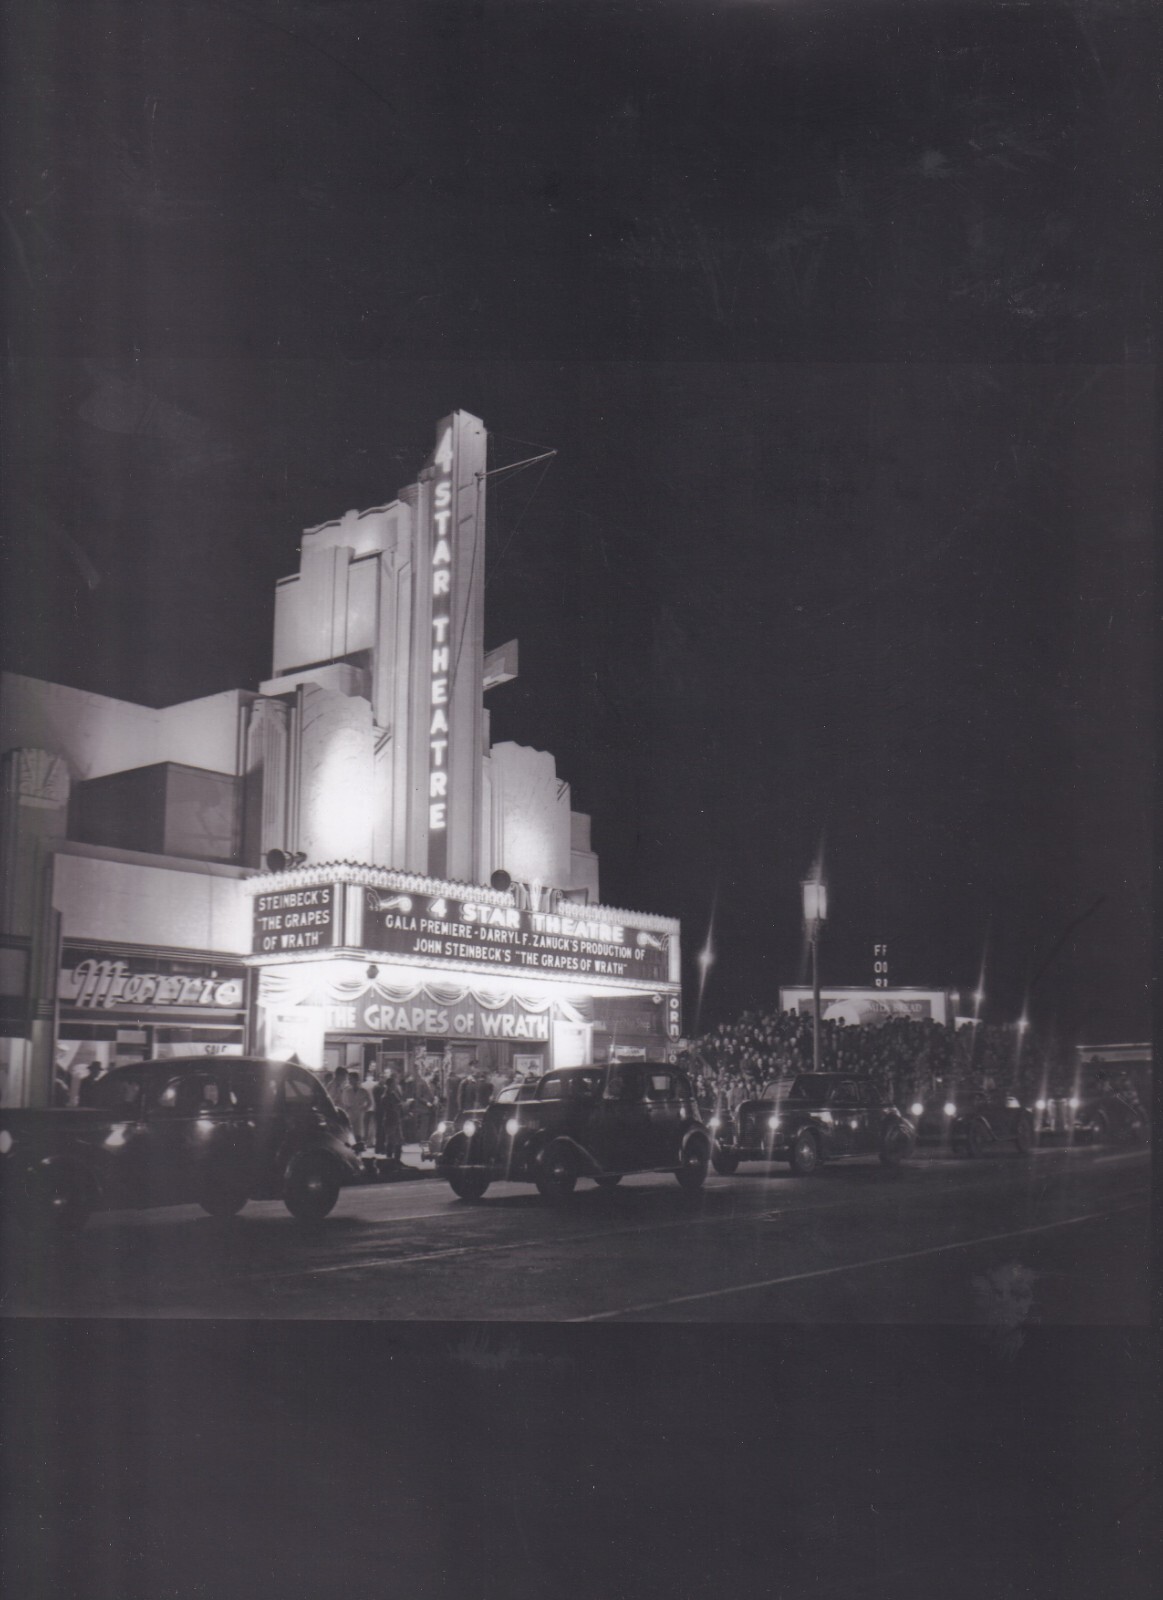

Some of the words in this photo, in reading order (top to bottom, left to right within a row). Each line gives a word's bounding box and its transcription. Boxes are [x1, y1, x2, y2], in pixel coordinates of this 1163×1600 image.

[435, 427, 452, 473] 4
[432, 481, 451, 596] STAR
[429, 616, 450, 830] THEATRE
[258, 889, 330, 912] STEINBECK'S
[284, 909, 330, 929] GRAPES
[429, 898, 447, 918] 4
[462, 903, 520, 929] STAR
[532, 913, 624, 943] THEATRE
[262, 935, 277, 951] OF
[385, 914, 417, 931] GALA
[420, 918, 473, 939] PREMIERE
[479, 926, 521, 946] DARRYL
[521, 932, 532, 946] F.
[532, 935, 579, 953] ZANUCK'S
[580, 941, 632, 960] PRODUCTION
[634, 948, 646, 961] OF
[413, 937, 442, 955] JOHN
[445, 941, 512, 963] STEINBECK'S
[540, 953, 579, 971] GRAPES
[579, 957, 592, 971] OF
[329, 1005, 357, 1029] THE
[363, 1003, 450, 1034] GRAPES
[453, 1013, 475, 1034] OF
[480, 1012, 549, 1039] WRATH
